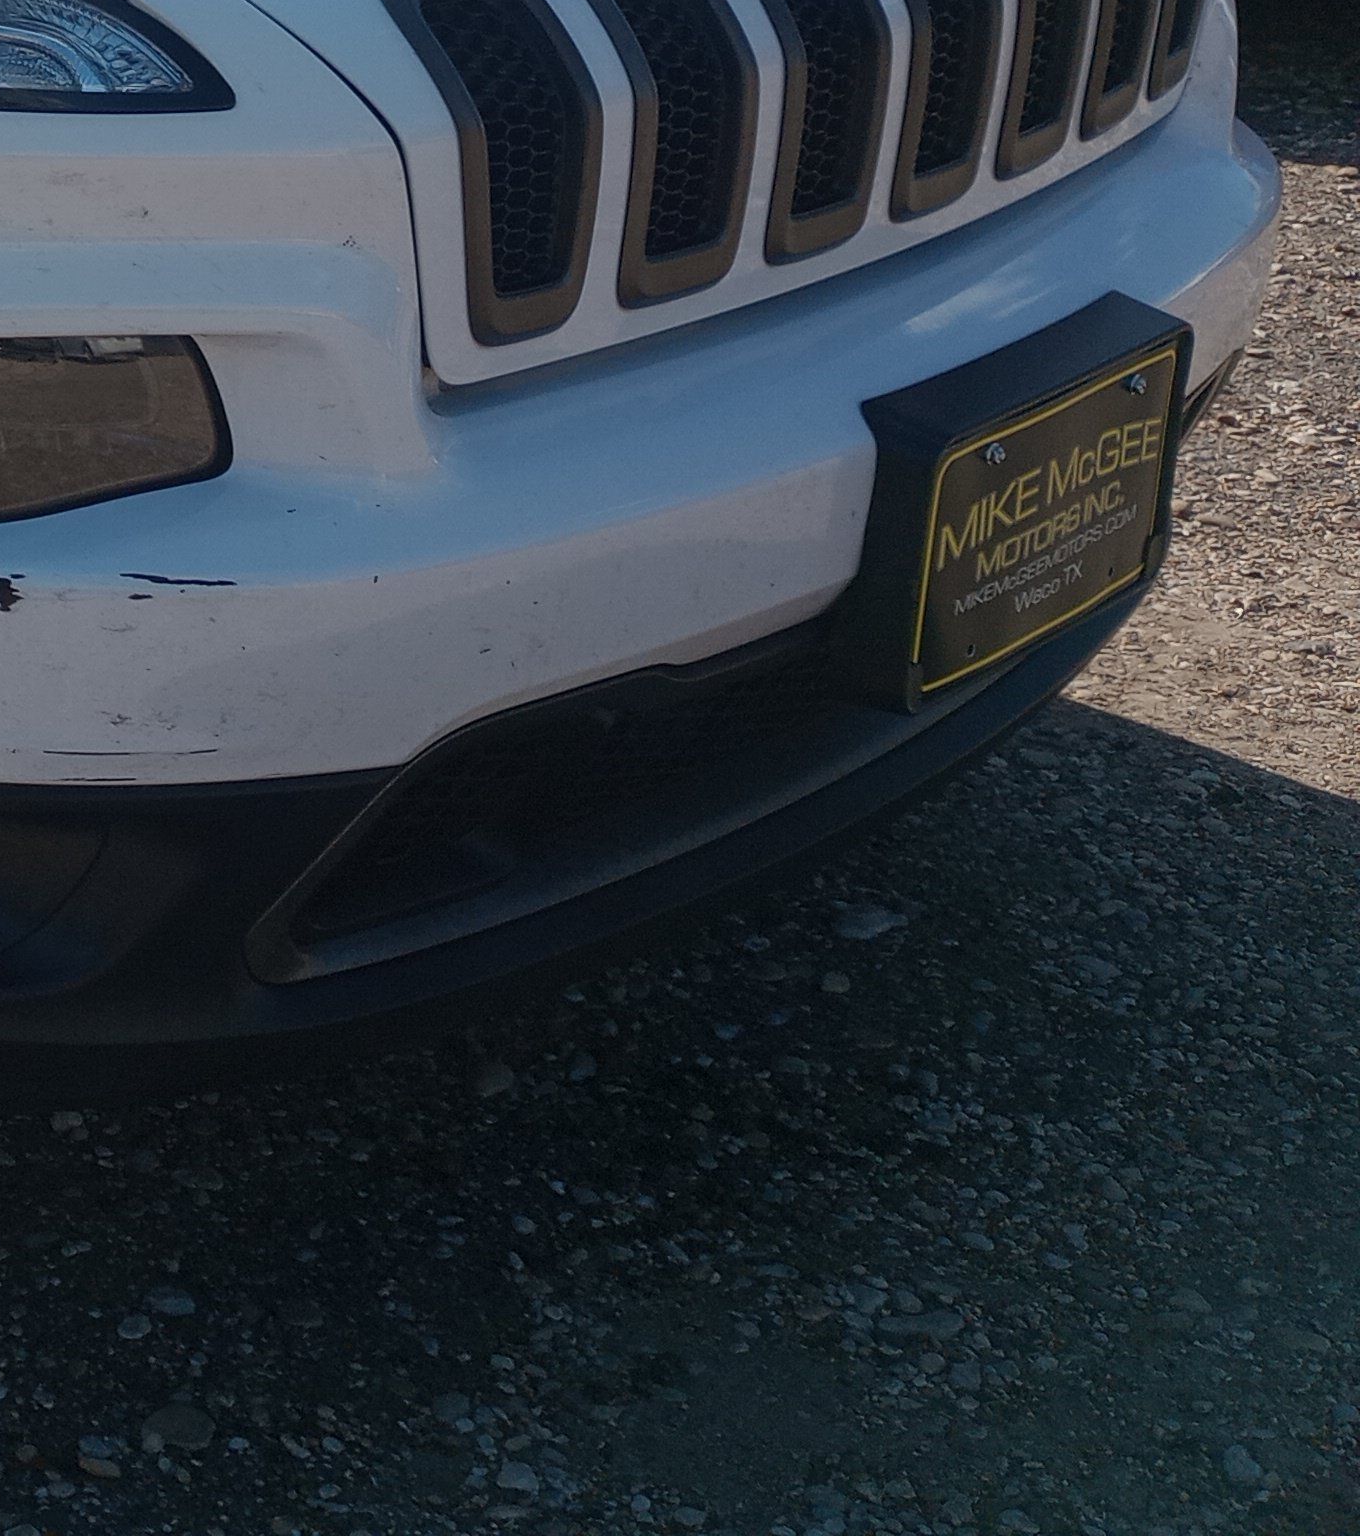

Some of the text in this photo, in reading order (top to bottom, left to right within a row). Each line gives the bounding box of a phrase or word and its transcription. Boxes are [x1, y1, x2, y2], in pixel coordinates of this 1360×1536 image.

[936, 417, 1163, 572] MIKE McGEE
[975, 502, 1081, 583] MOTORS
[1062, 559, 1084, 586] TX
